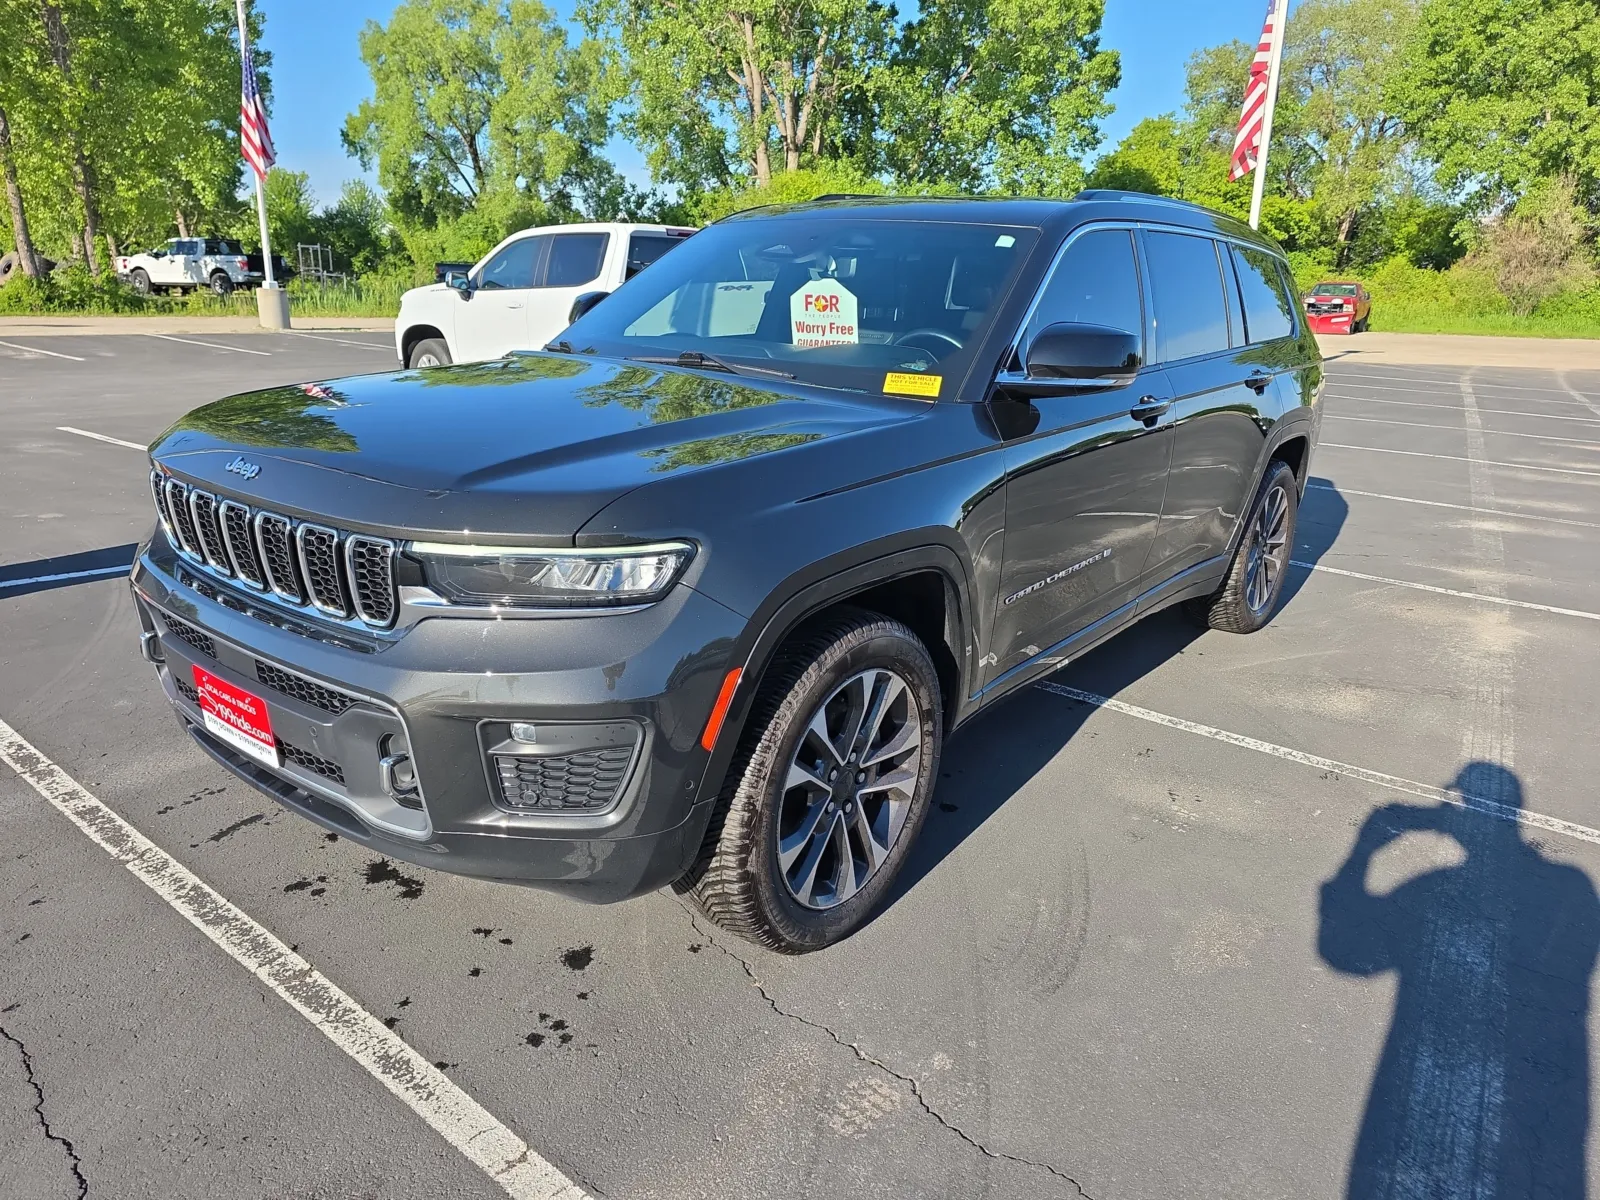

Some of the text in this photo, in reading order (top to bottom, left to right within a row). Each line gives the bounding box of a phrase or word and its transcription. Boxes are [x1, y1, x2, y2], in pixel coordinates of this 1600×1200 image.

[804, 294, 840, 313] FOR
[795, 321, 826, 336] Worry
[829, 322, 854, 336] Free
[225, 456, 259, 480] Jeep
[1005, 580, 1045, 605] GRAND
[1046, 552, 1103, 584] CHEROKEE
[204, 682, 219, 696] LOCAL
[219, 691, 231, 703] CARS
[236, 700, 256, 715] TRUCKS
[207, 715, 219, 727] $199
[219, 723, 234, 737] DOWN
